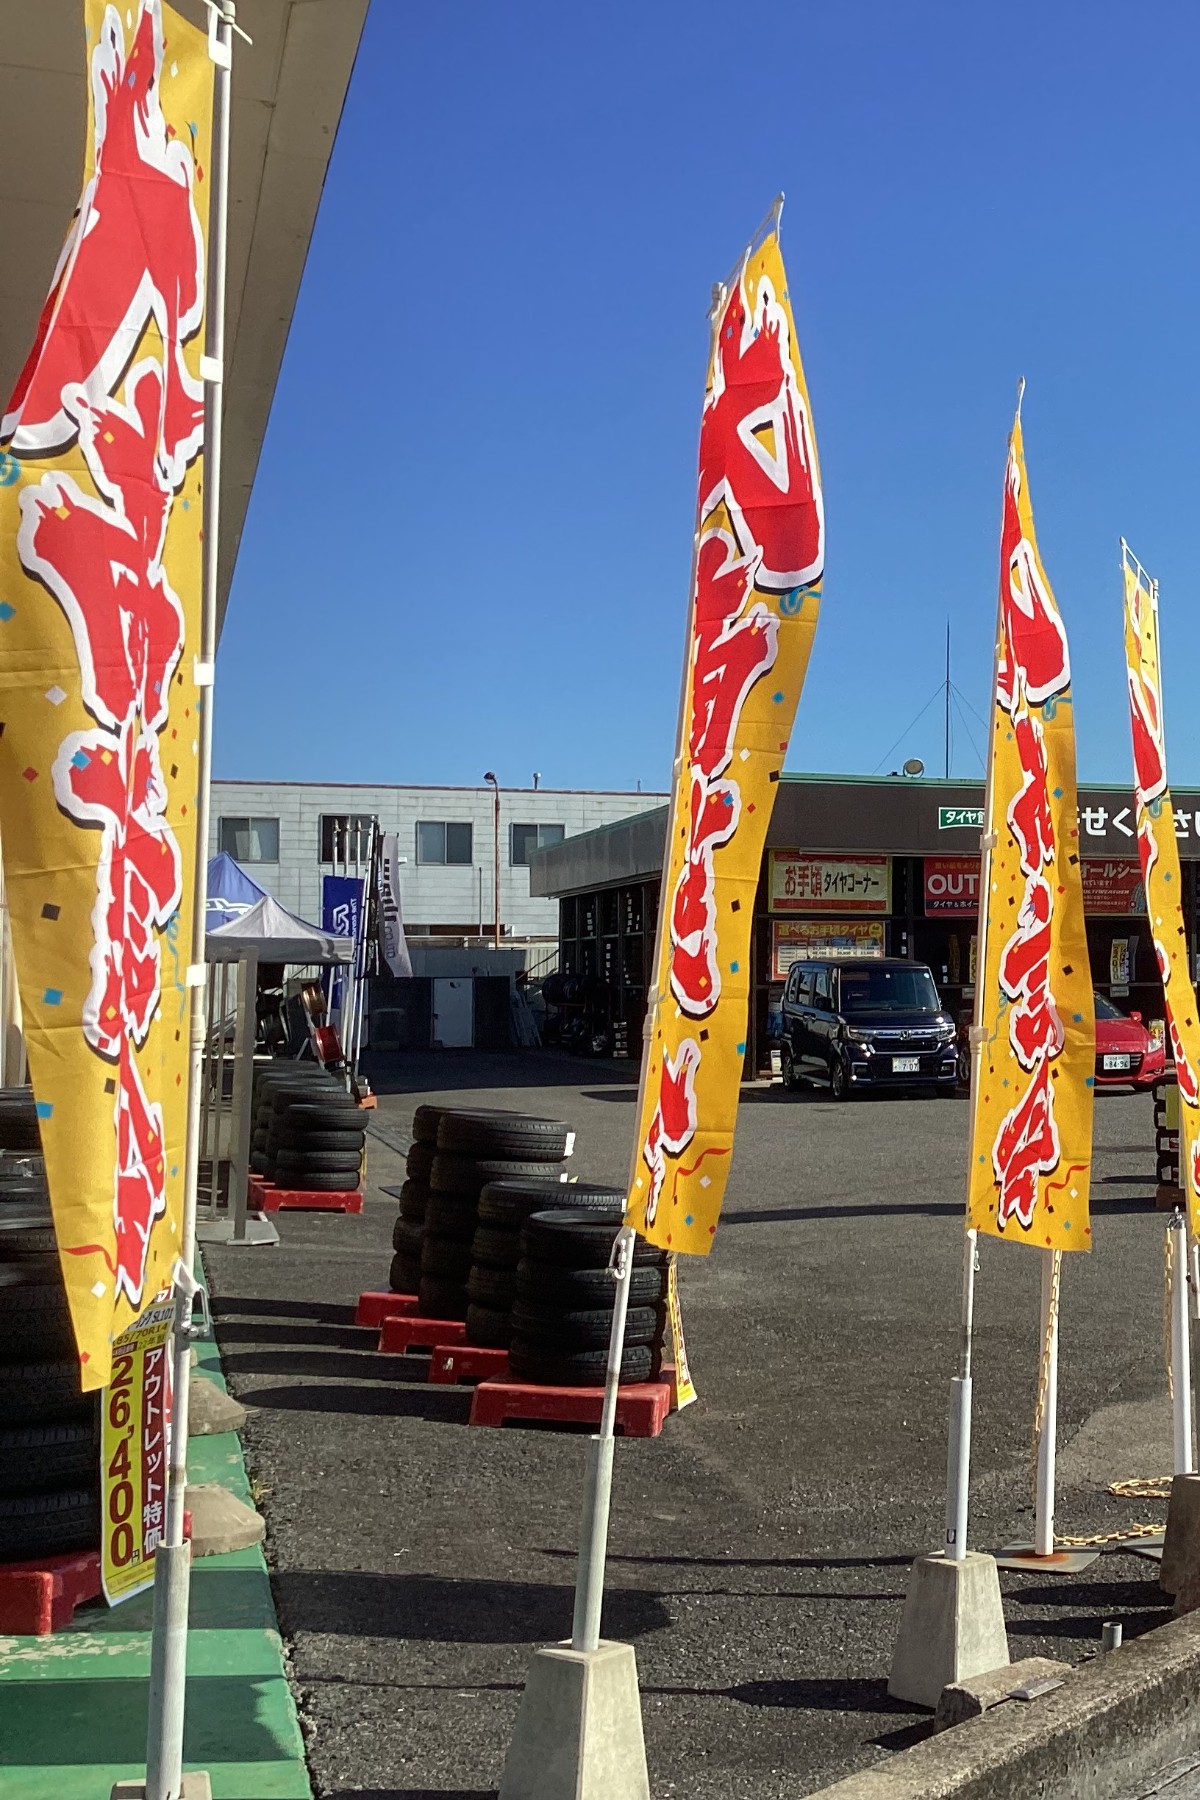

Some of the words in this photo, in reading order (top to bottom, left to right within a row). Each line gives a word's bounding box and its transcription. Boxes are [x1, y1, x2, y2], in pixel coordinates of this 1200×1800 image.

[143, 1348, 165, 1554] アウトレット特価
